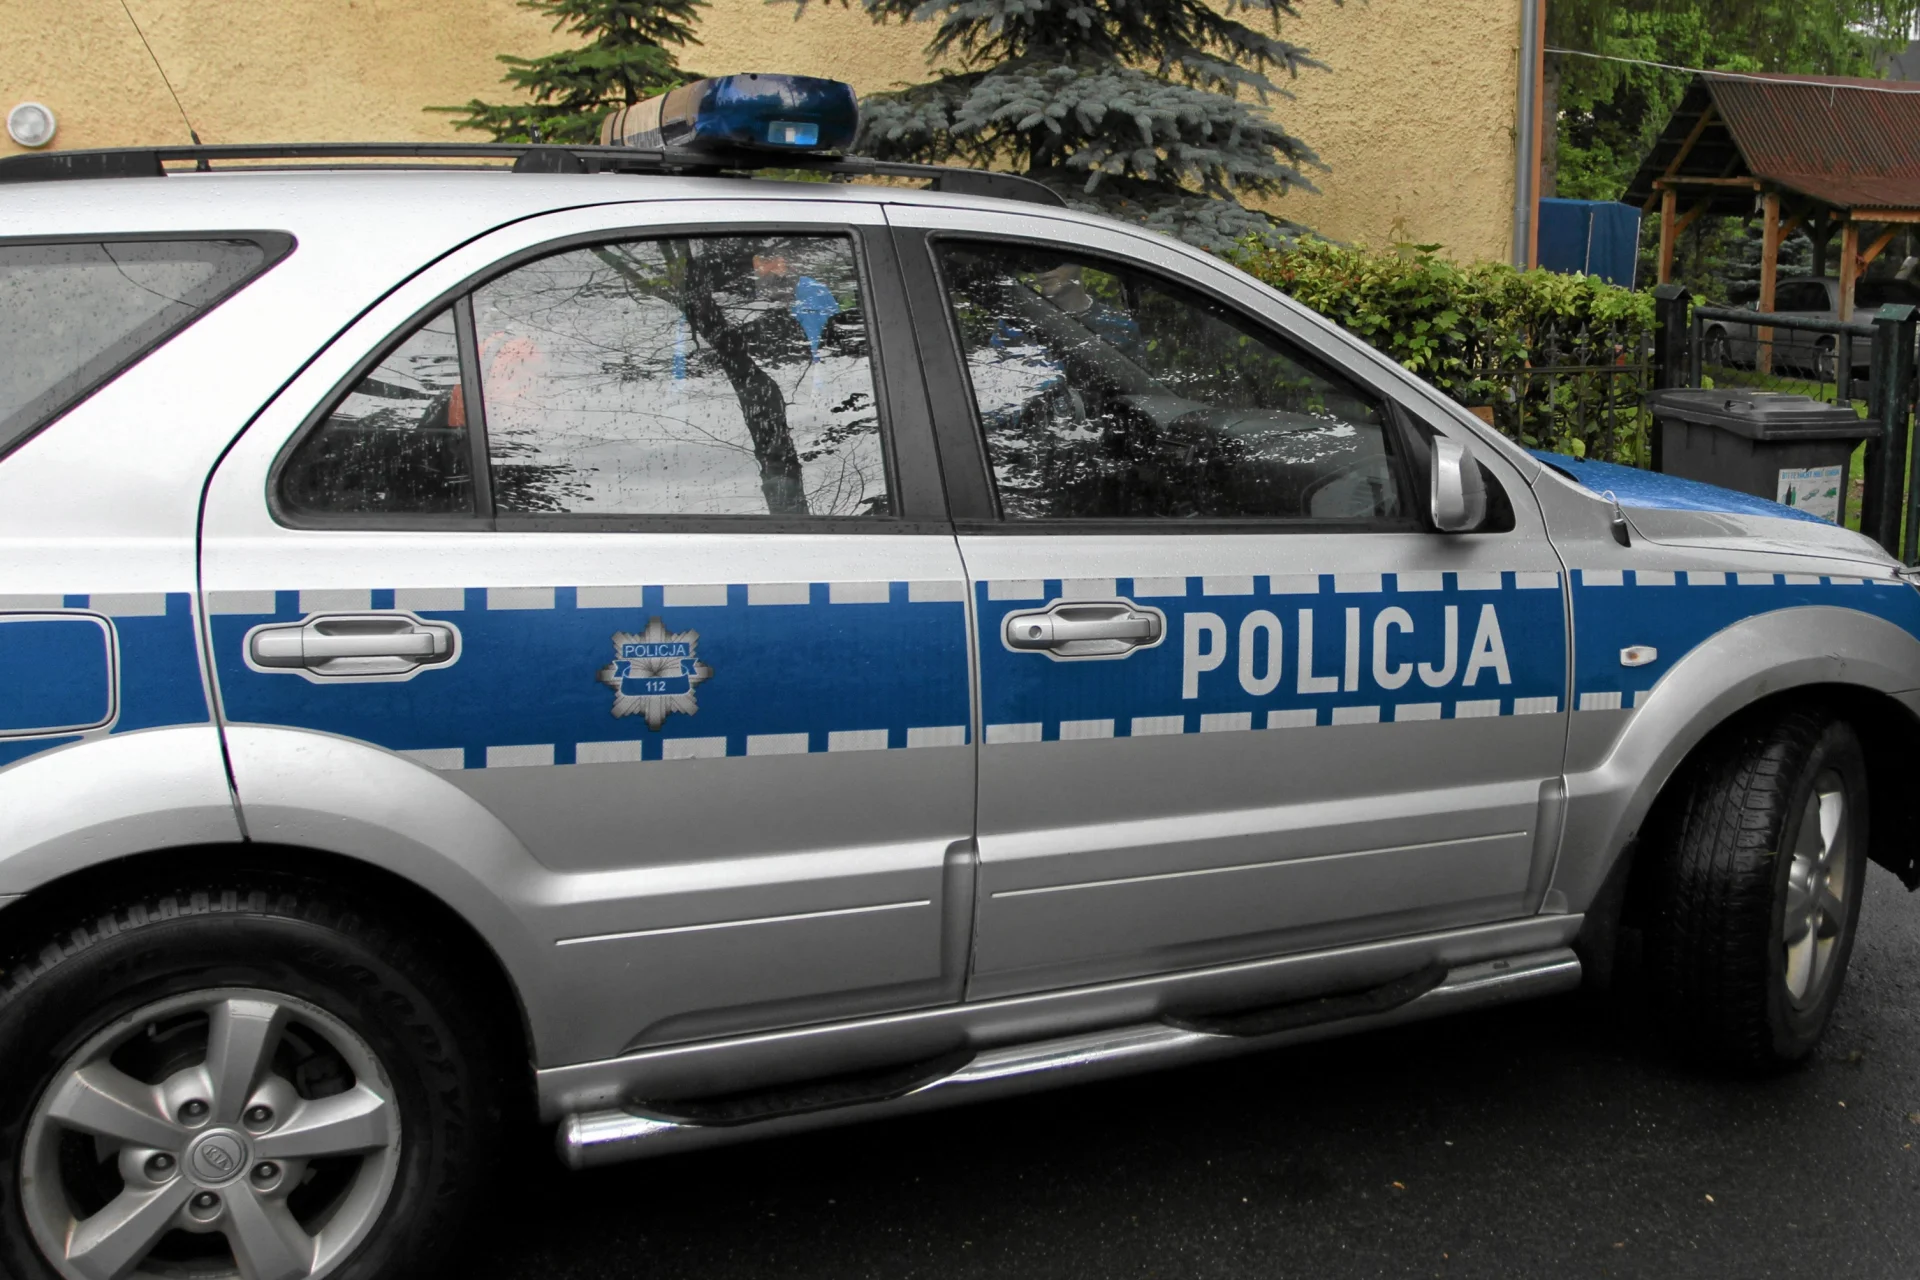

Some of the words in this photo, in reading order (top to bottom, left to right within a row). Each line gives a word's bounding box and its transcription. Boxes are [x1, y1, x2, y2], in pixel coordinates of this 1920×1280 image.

[624, 644, 686, 658] POLICJA
[1182, 603, 1512, 700] POLICJA
[645, 681, 666, 692] 112
[204, 1146, 232, 1171] KIA
